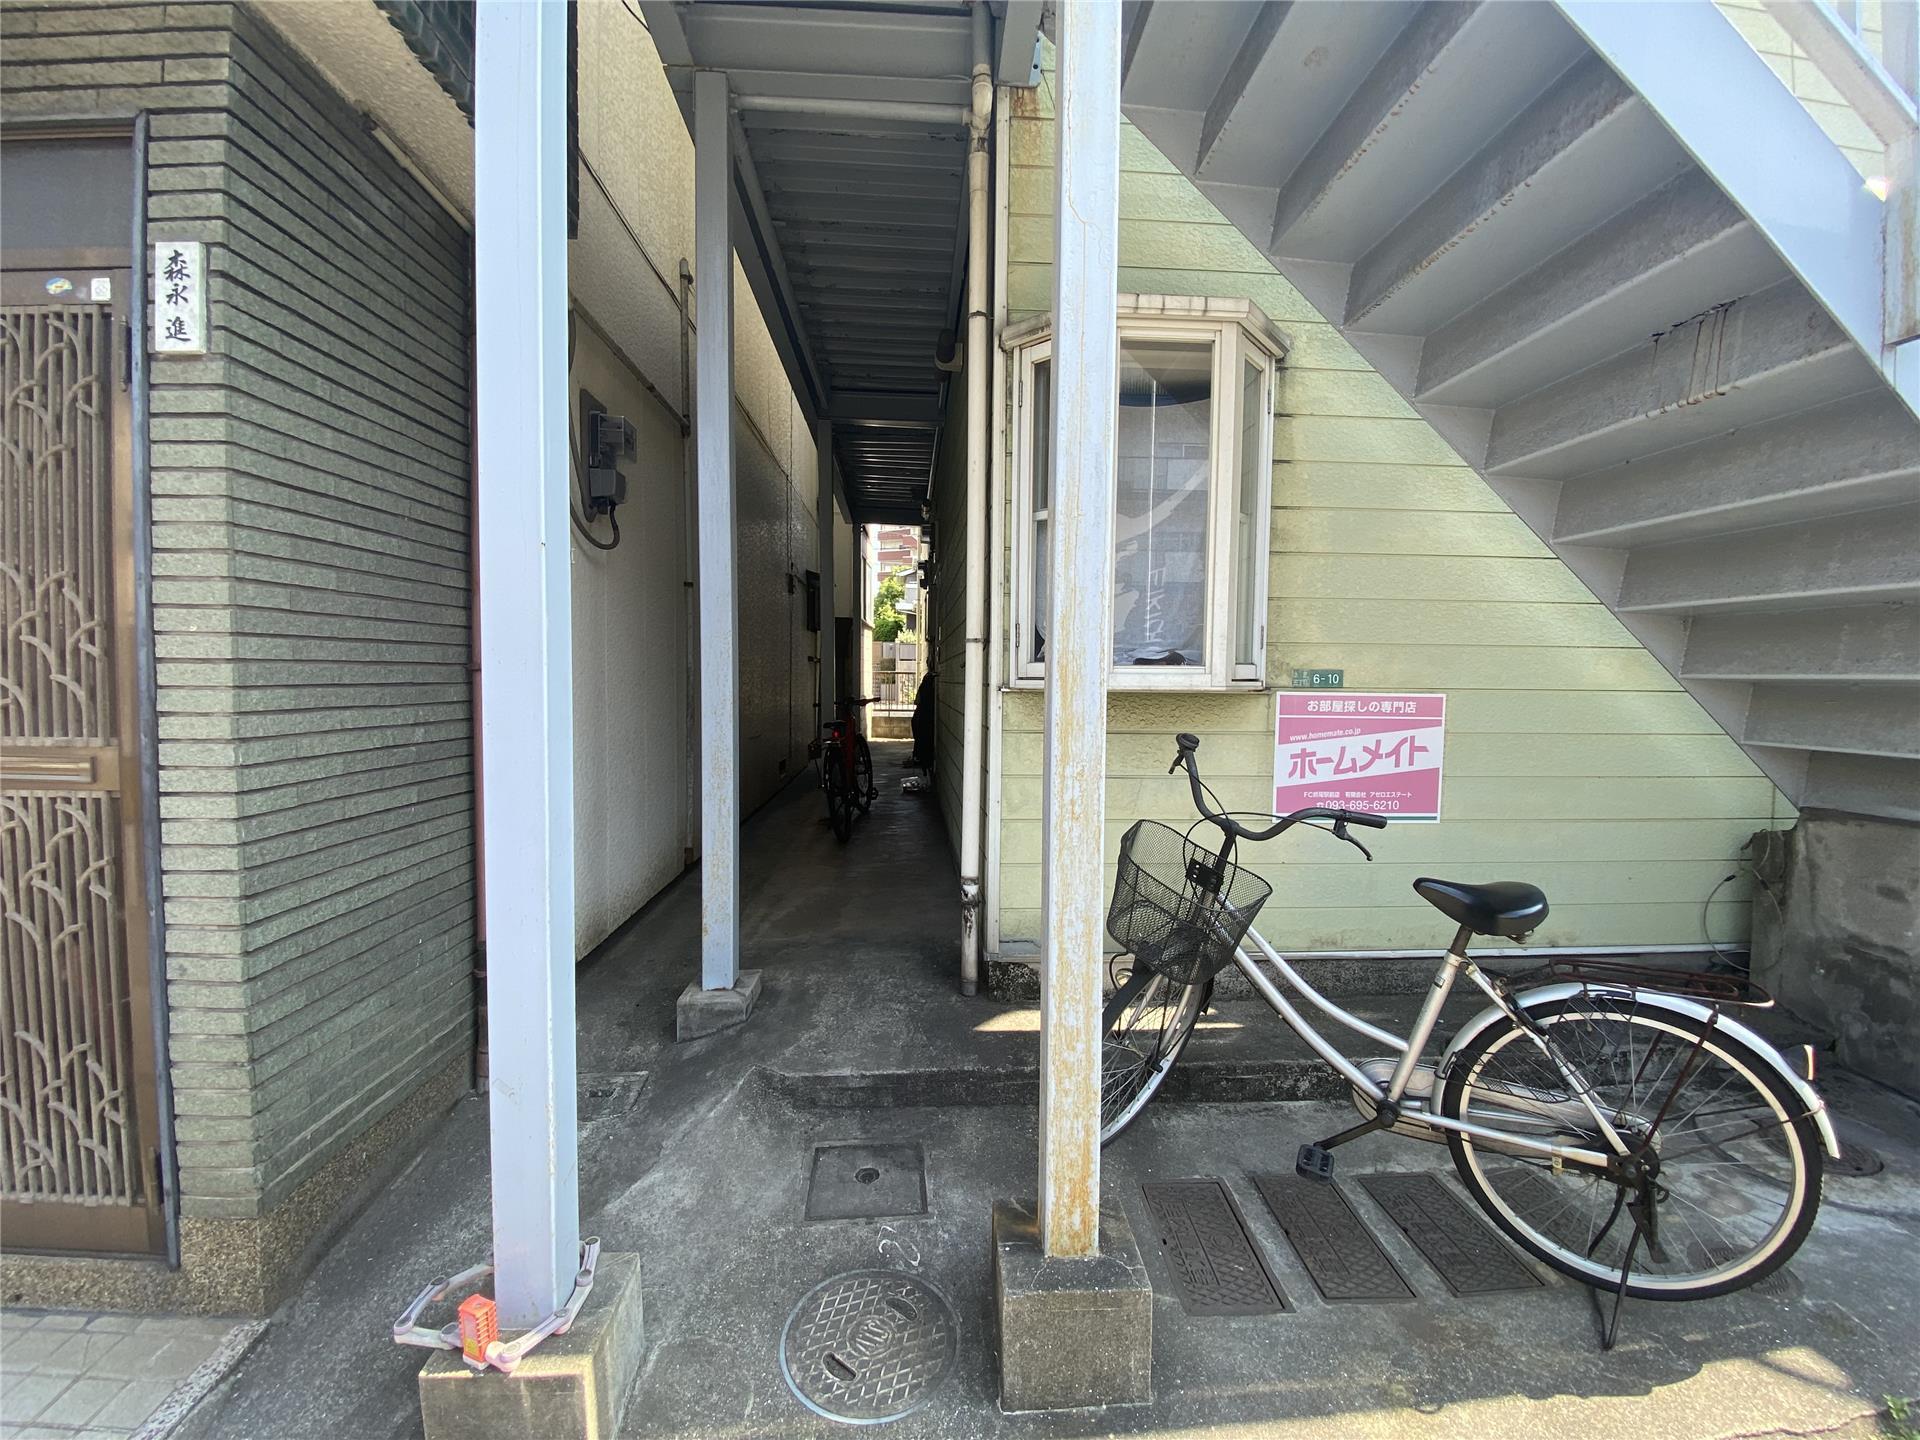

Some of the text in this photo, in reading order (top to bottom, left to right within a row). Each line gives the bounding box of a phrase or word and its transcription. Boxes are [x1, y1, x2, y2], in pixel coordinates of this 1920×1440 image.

[1313, 673, 1340, 684] 6-10
[1307, 700, 1417, 714] お部屋探しの専門店
[1290, 727, 1361, 742] www.homemate.co.jp
[1287, 735, 1430, 779] ホームメイト
[1325, 800, 1400, 811] 093-695-6210
